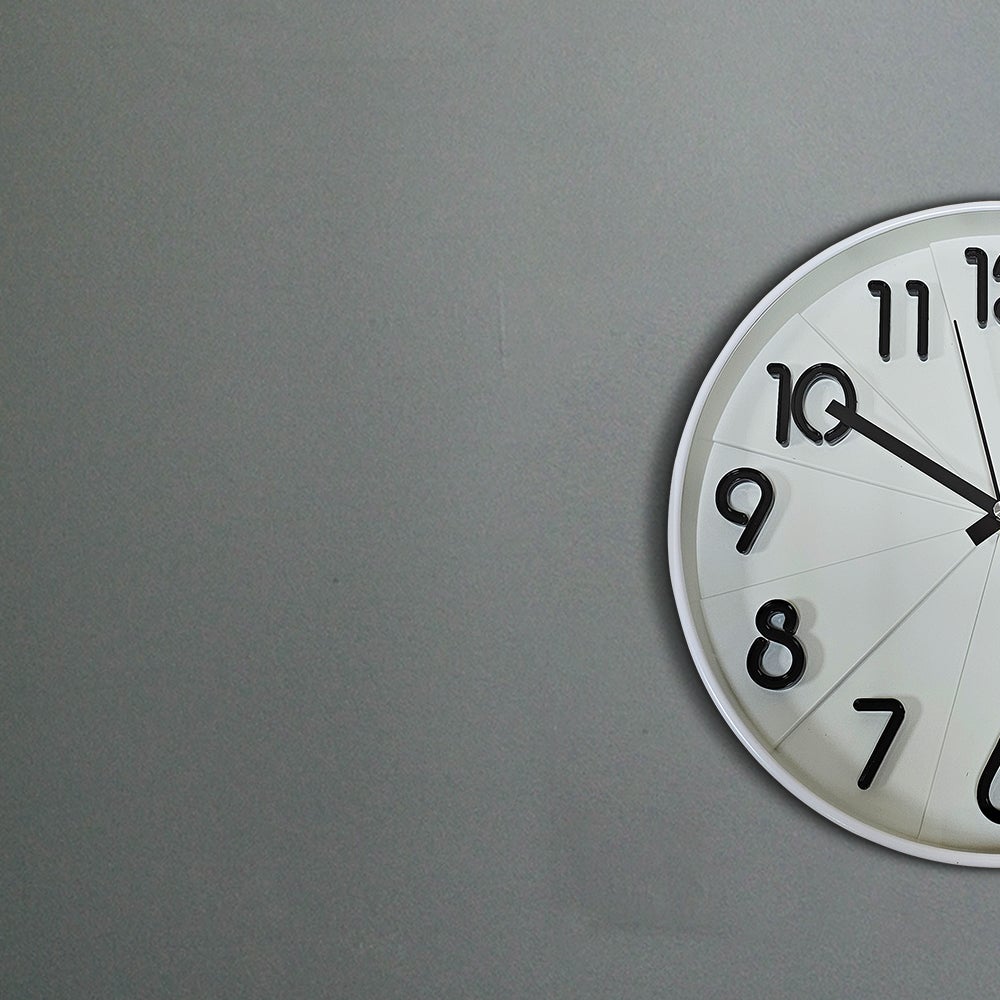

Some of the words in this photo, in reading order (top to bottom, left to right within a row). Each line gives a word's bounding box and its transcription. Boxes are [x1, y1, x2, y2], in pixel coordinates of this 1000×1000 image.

[868, 280, 930, 361] 11
[767, 363, 857, 447] 10
[715, 468, 775, 555] 9
[746, 599, 807, 691] 8
[852, 698, 906, 791] 7
